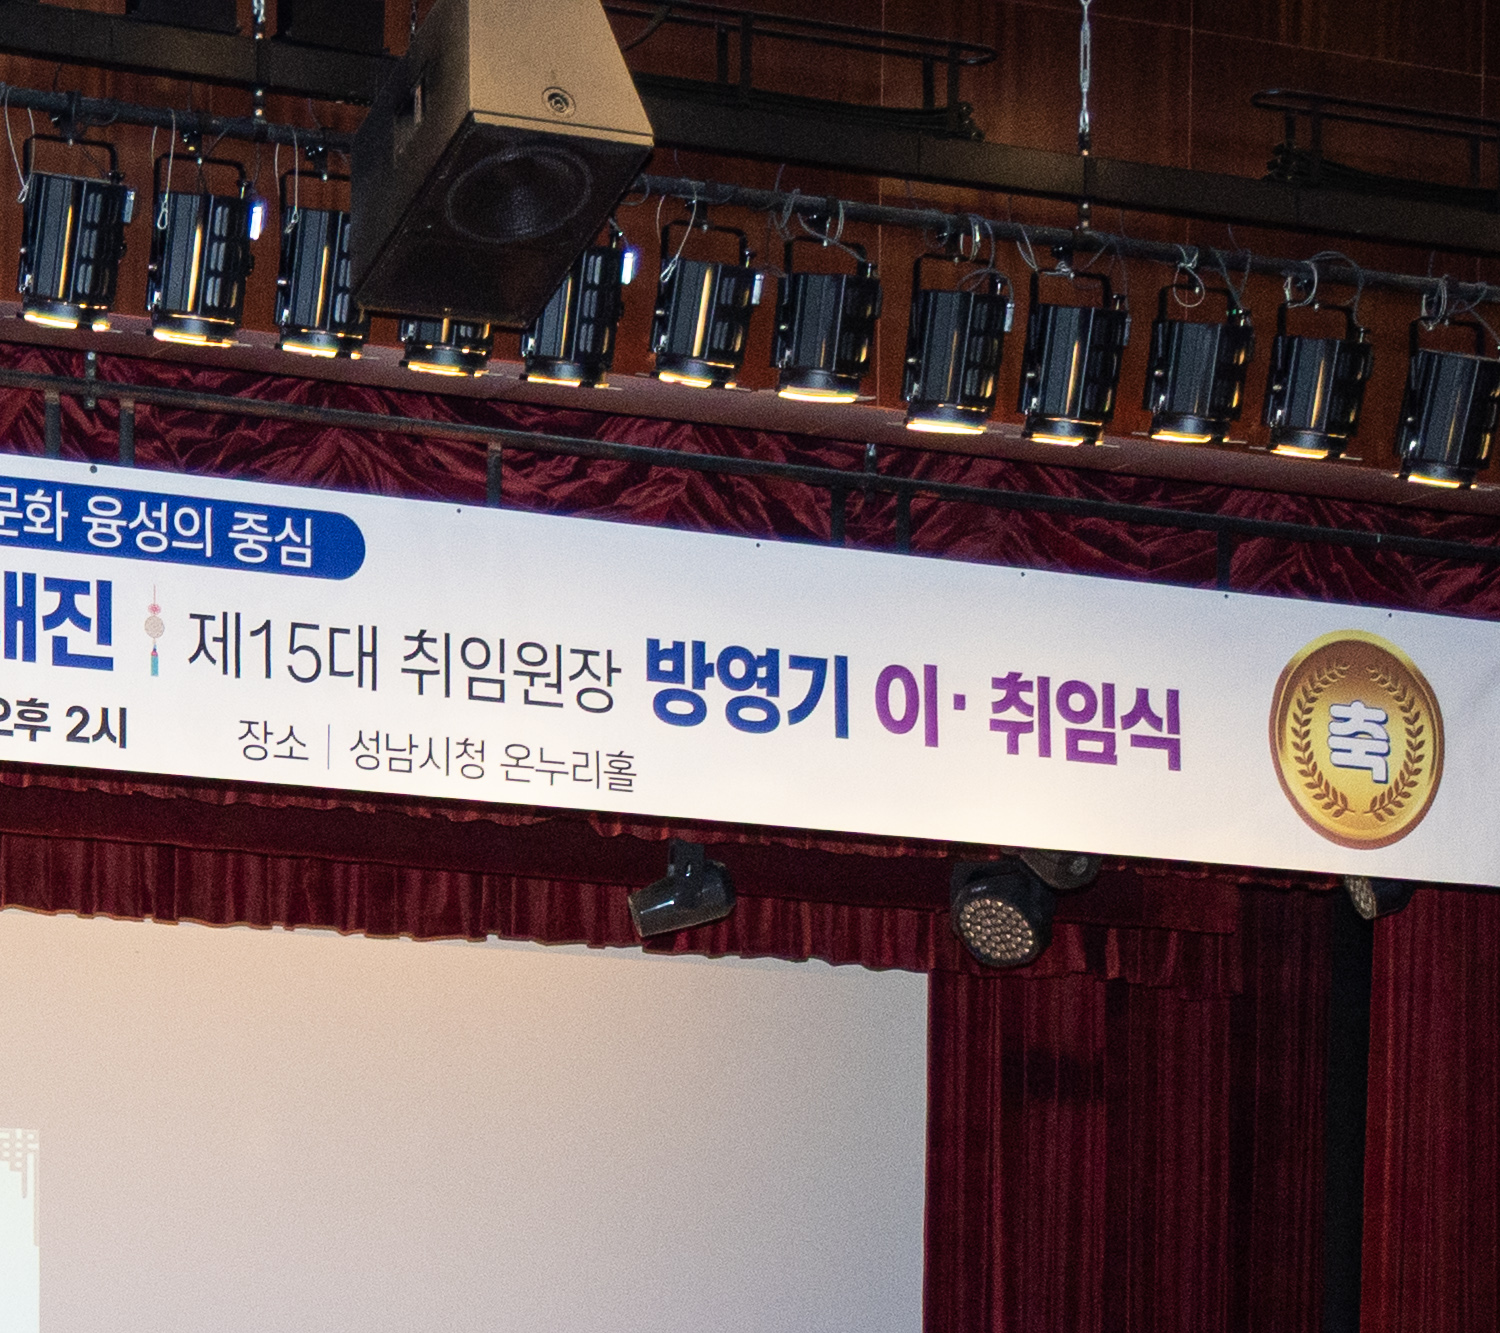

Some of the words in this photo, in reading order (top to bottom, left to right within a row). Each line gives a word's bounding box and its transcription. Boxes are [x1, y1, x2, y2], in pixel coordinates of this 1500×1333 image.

[82, 495, 214, 559] 융성의
[228, 509, 316, 567] 중심
[66, 701, 130, 751] 2시
[187, 608, 380, 691] 제15대
[399, 631, 622, 714] 취임원장
[644, 637, 850, 740] 방영기
[987, 670, 1184, 772] 취임식
[237, 717, 311, 763] 장소
[348, 725, 487, 784] 성남시청
[498, 744, 637, 793] 온누리홀
[1326, 699, 1391, 784] 축
